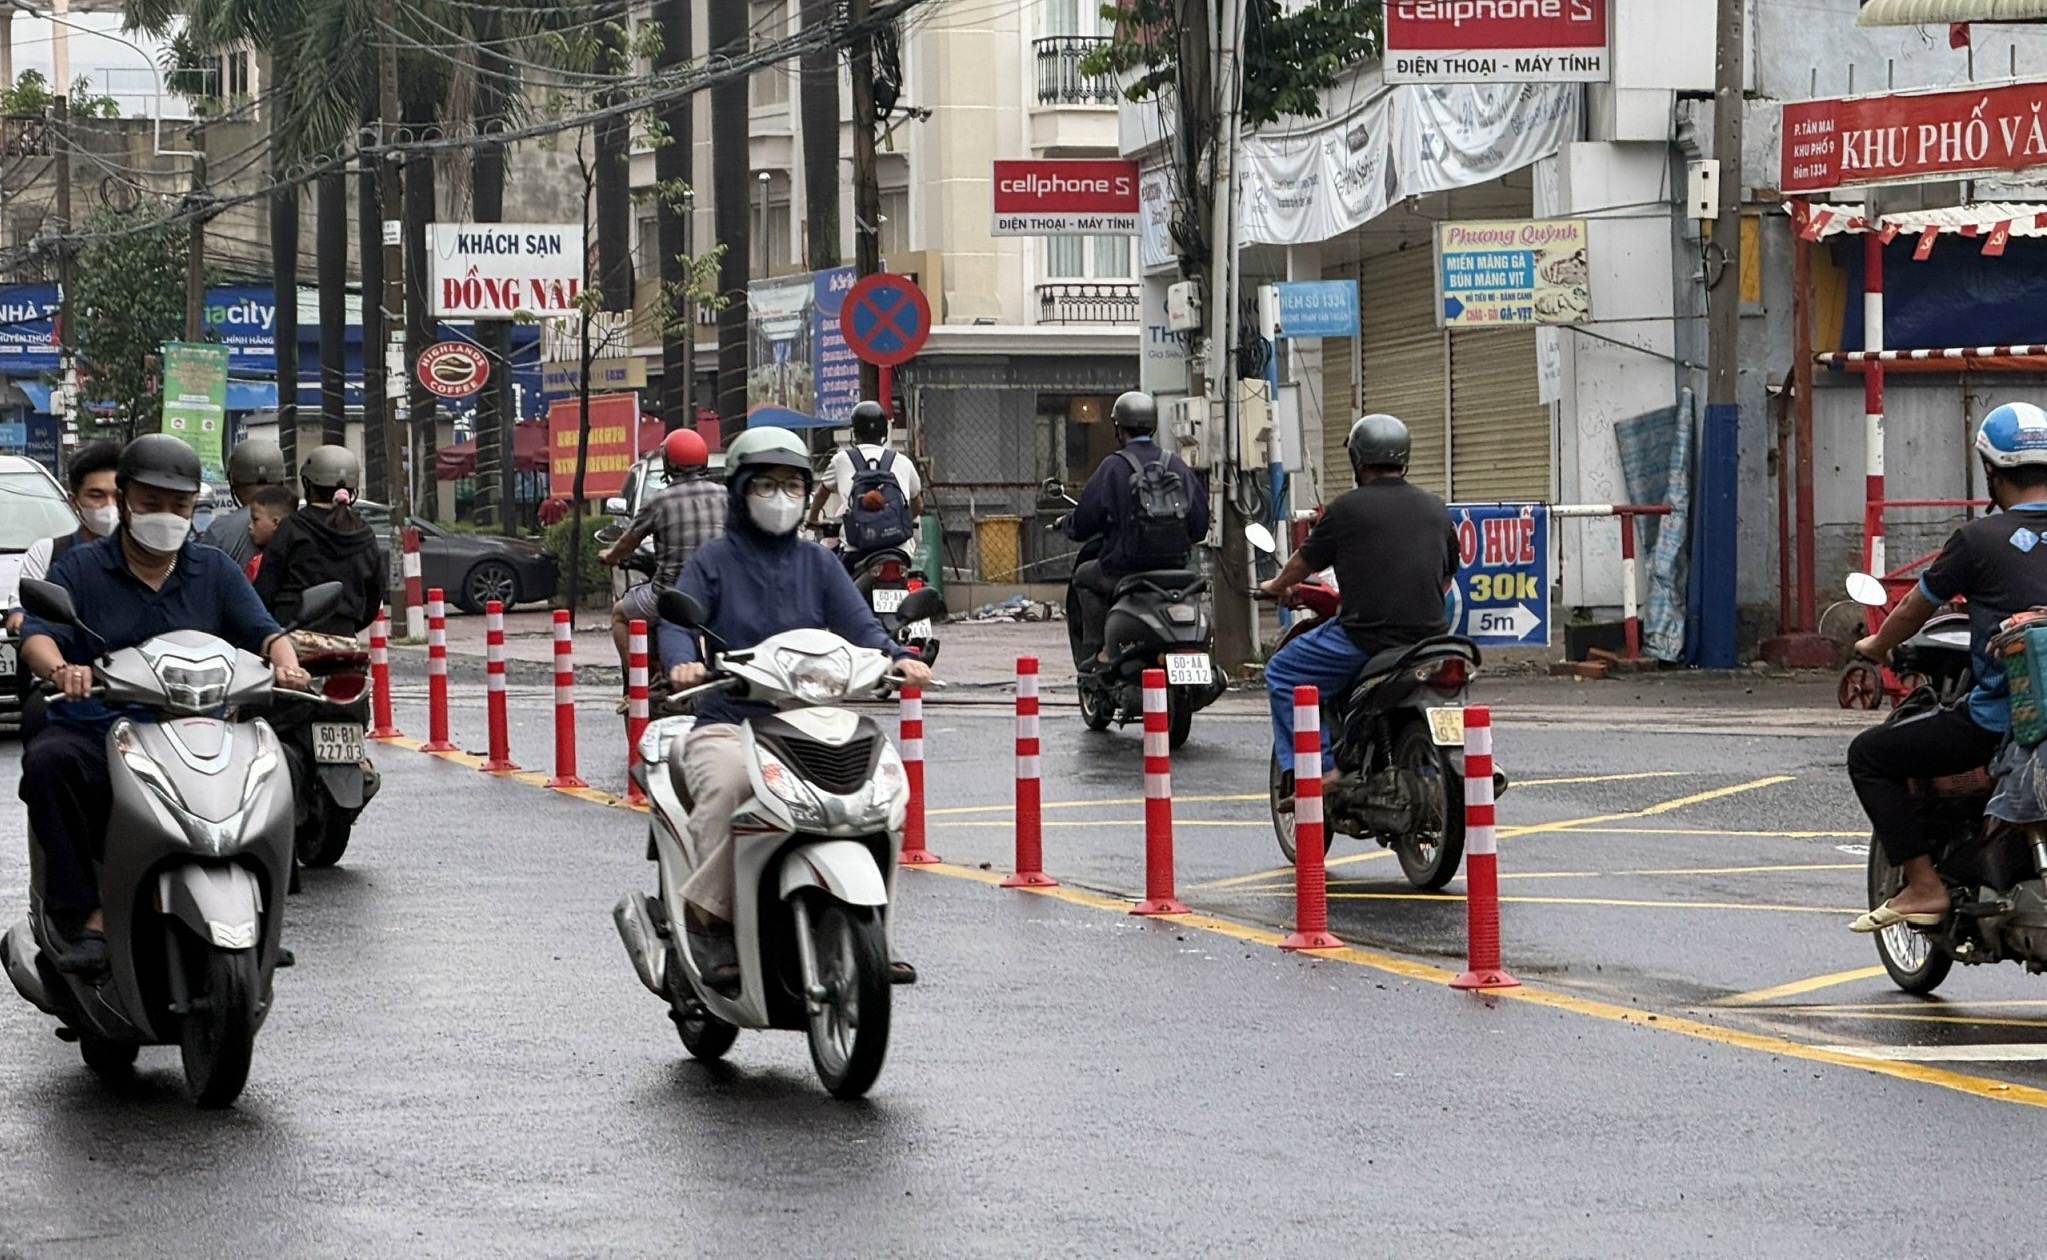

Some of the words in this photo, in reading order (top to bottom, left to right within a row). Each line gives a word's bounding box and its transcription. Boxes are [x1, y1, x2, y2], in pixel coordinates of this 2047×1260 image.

[1397, 0, 1561, 27] cellphone
[1397, 56, 1438, 76] ĐIỆN
[1443, 59, 1497, 77] THOẠI
[1515, 54, 1554, 73] MÁY
[1558, 53, 1600, 71] TÍNH
[1794, 124, 1801, 136] P.
[1802, 119, 1817, 135] TÂN
[1819, 119, 1834, 133] MAI
[1841, 126, 1908, 169] KHU
[1917, 97, 1989, 165] PHỐ
[1794, 144, 1810, 158] KHU
[1811, 136, 1828, 155] PHỐ
[1829, 141, 1834, 153] 9
[1810, 163, 1827, 179] 1334
[1000, 174, 1109, 198] cellphone
[999, 216, 1027, 231] ĐIỆN
[1030, 218, 1066, 231] THOẠI
[1078, 216, 1104, 229] MÁY
[1106, 215, 1135, 229] TÍNH
[458, 228, 519, 254] KHÁCH
[526, 234, 562, 258] SẠN
[1448, 227, 1515, 246] Phương
[1520, 223, 1578, 244] Quỳnh
[1447, 253, 1474, 270] MIẾN
[1477, 253, 1508, 269] MĂNG
[1511, 252, 1526, 269] GÀ
[443, 264, 520, 310] ĐỒNG
[529, 278, 580, 310] NAI
[1450, 271, 1472, 288] BÚN
[1475, 271, 1506, 286] MĂNG
[1509, 271, 1525, 288] VỊT
[0, 300, 38, 322] NHÀ
[1323, 294, 1346, 307] 1334
[421, 344, 485, 368] HIGHLANDS
[430, 381, 478, 394] COFFEE
[1482, 505, 1535, 567] HUẾ
[1469, 572, 1539, 602] 30k
[1480, 613, 1515, 631] 5m
[1171, 670, 1208, 682] 503.12
[318, 744, 363, 760] 227.03
